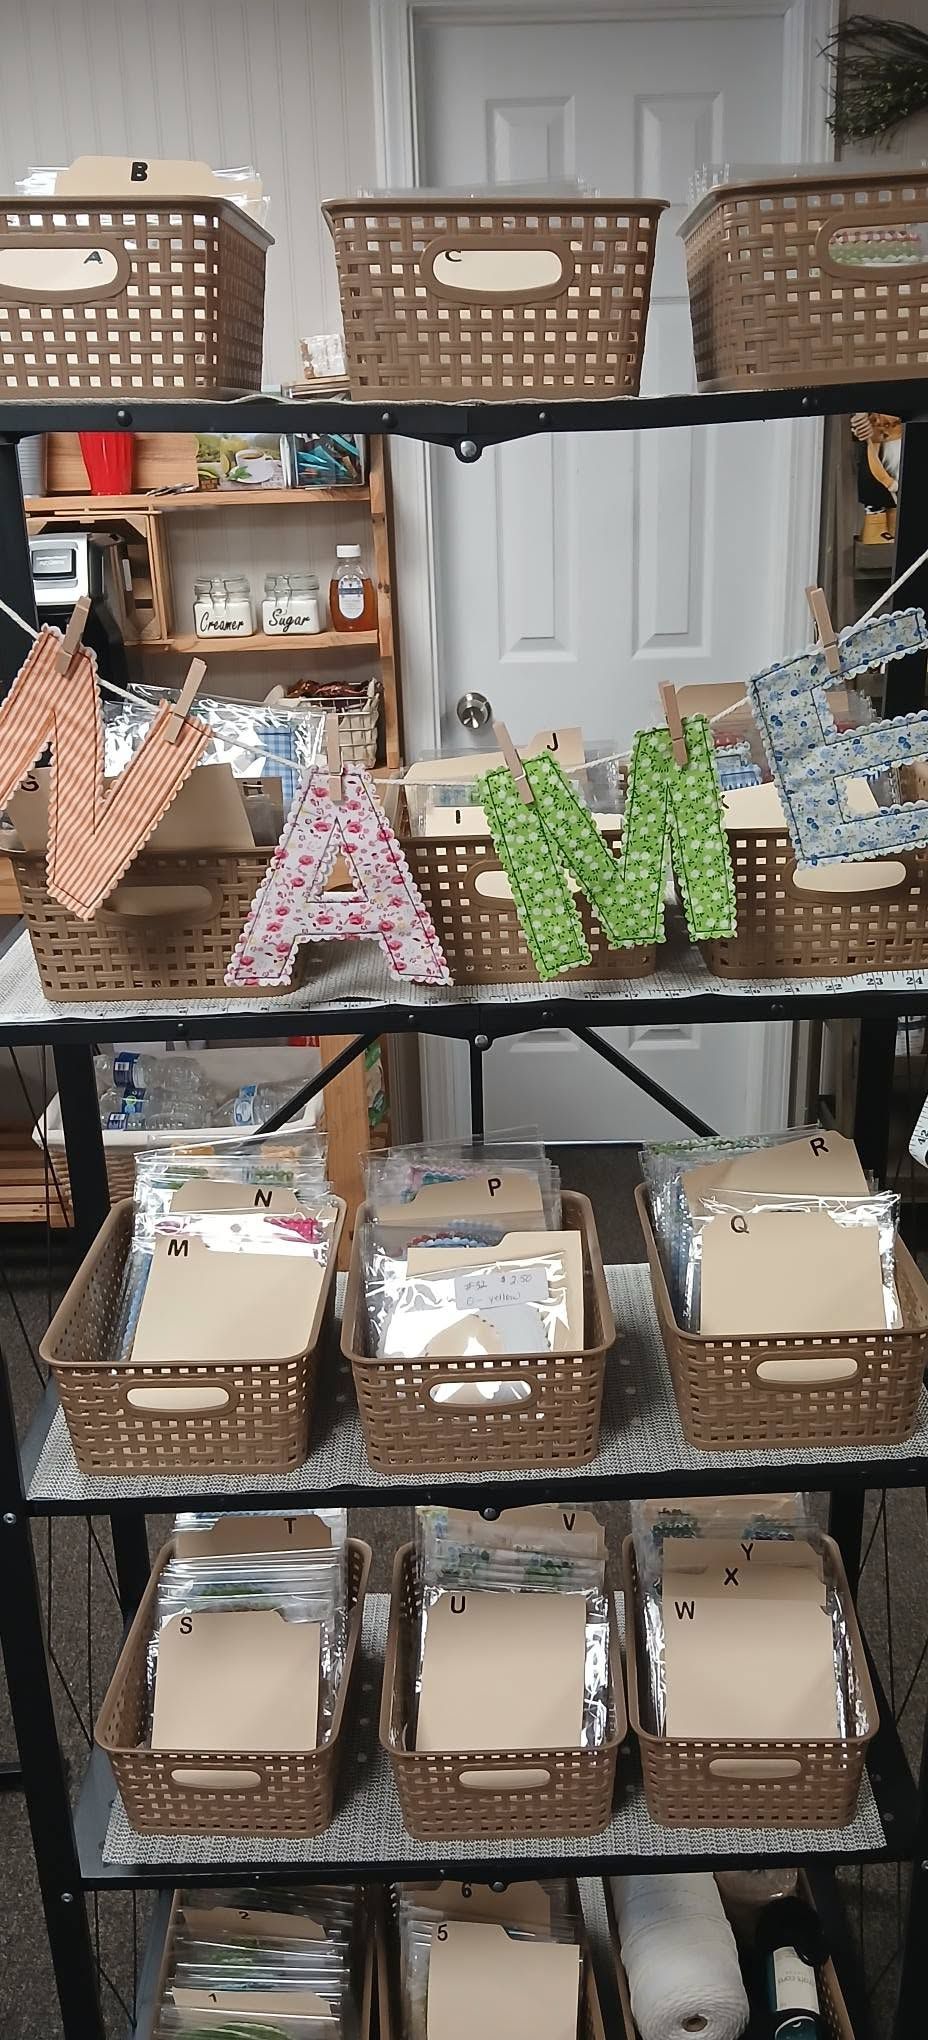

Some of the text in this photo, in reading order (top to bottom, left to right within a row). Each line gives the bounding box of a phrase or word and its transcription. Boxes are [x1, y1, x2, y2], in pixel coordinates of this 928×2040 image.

[131, 161, 149, 182] B
[84, 250, 103, 264] A
[445, 250, 462, 262] C
[200, 611, 244, 632] Creamer
[268, 608, 310, 632] Sugar
[547, 733, 559, 751] J
[866, 977, 884, 986] 23
[905, 976, 923, 985] 24
[810, 1137, 829, 1156] R
[487, 1177, 501, 1197] P
[254, 1188, 273, 1207] N
[730, 1214, 750, 1234] Q
[167, 1239, 189, 1257] M
[283, 1517, 297, 1534] T
[562, 1512, 576, 1531] V
[740, 1542, 754, 1561] Y
[724, 1567, 739, 1586] X
[450, 1595, 466, 1614] U
[675, 1600, 695, 1620] W
[179, 1616, 193, 1634] S
[461, 1882, 473, 1899] 6
[238, 1910, 251, 1920] 2
[437, 1923, 448, 1942] 5
